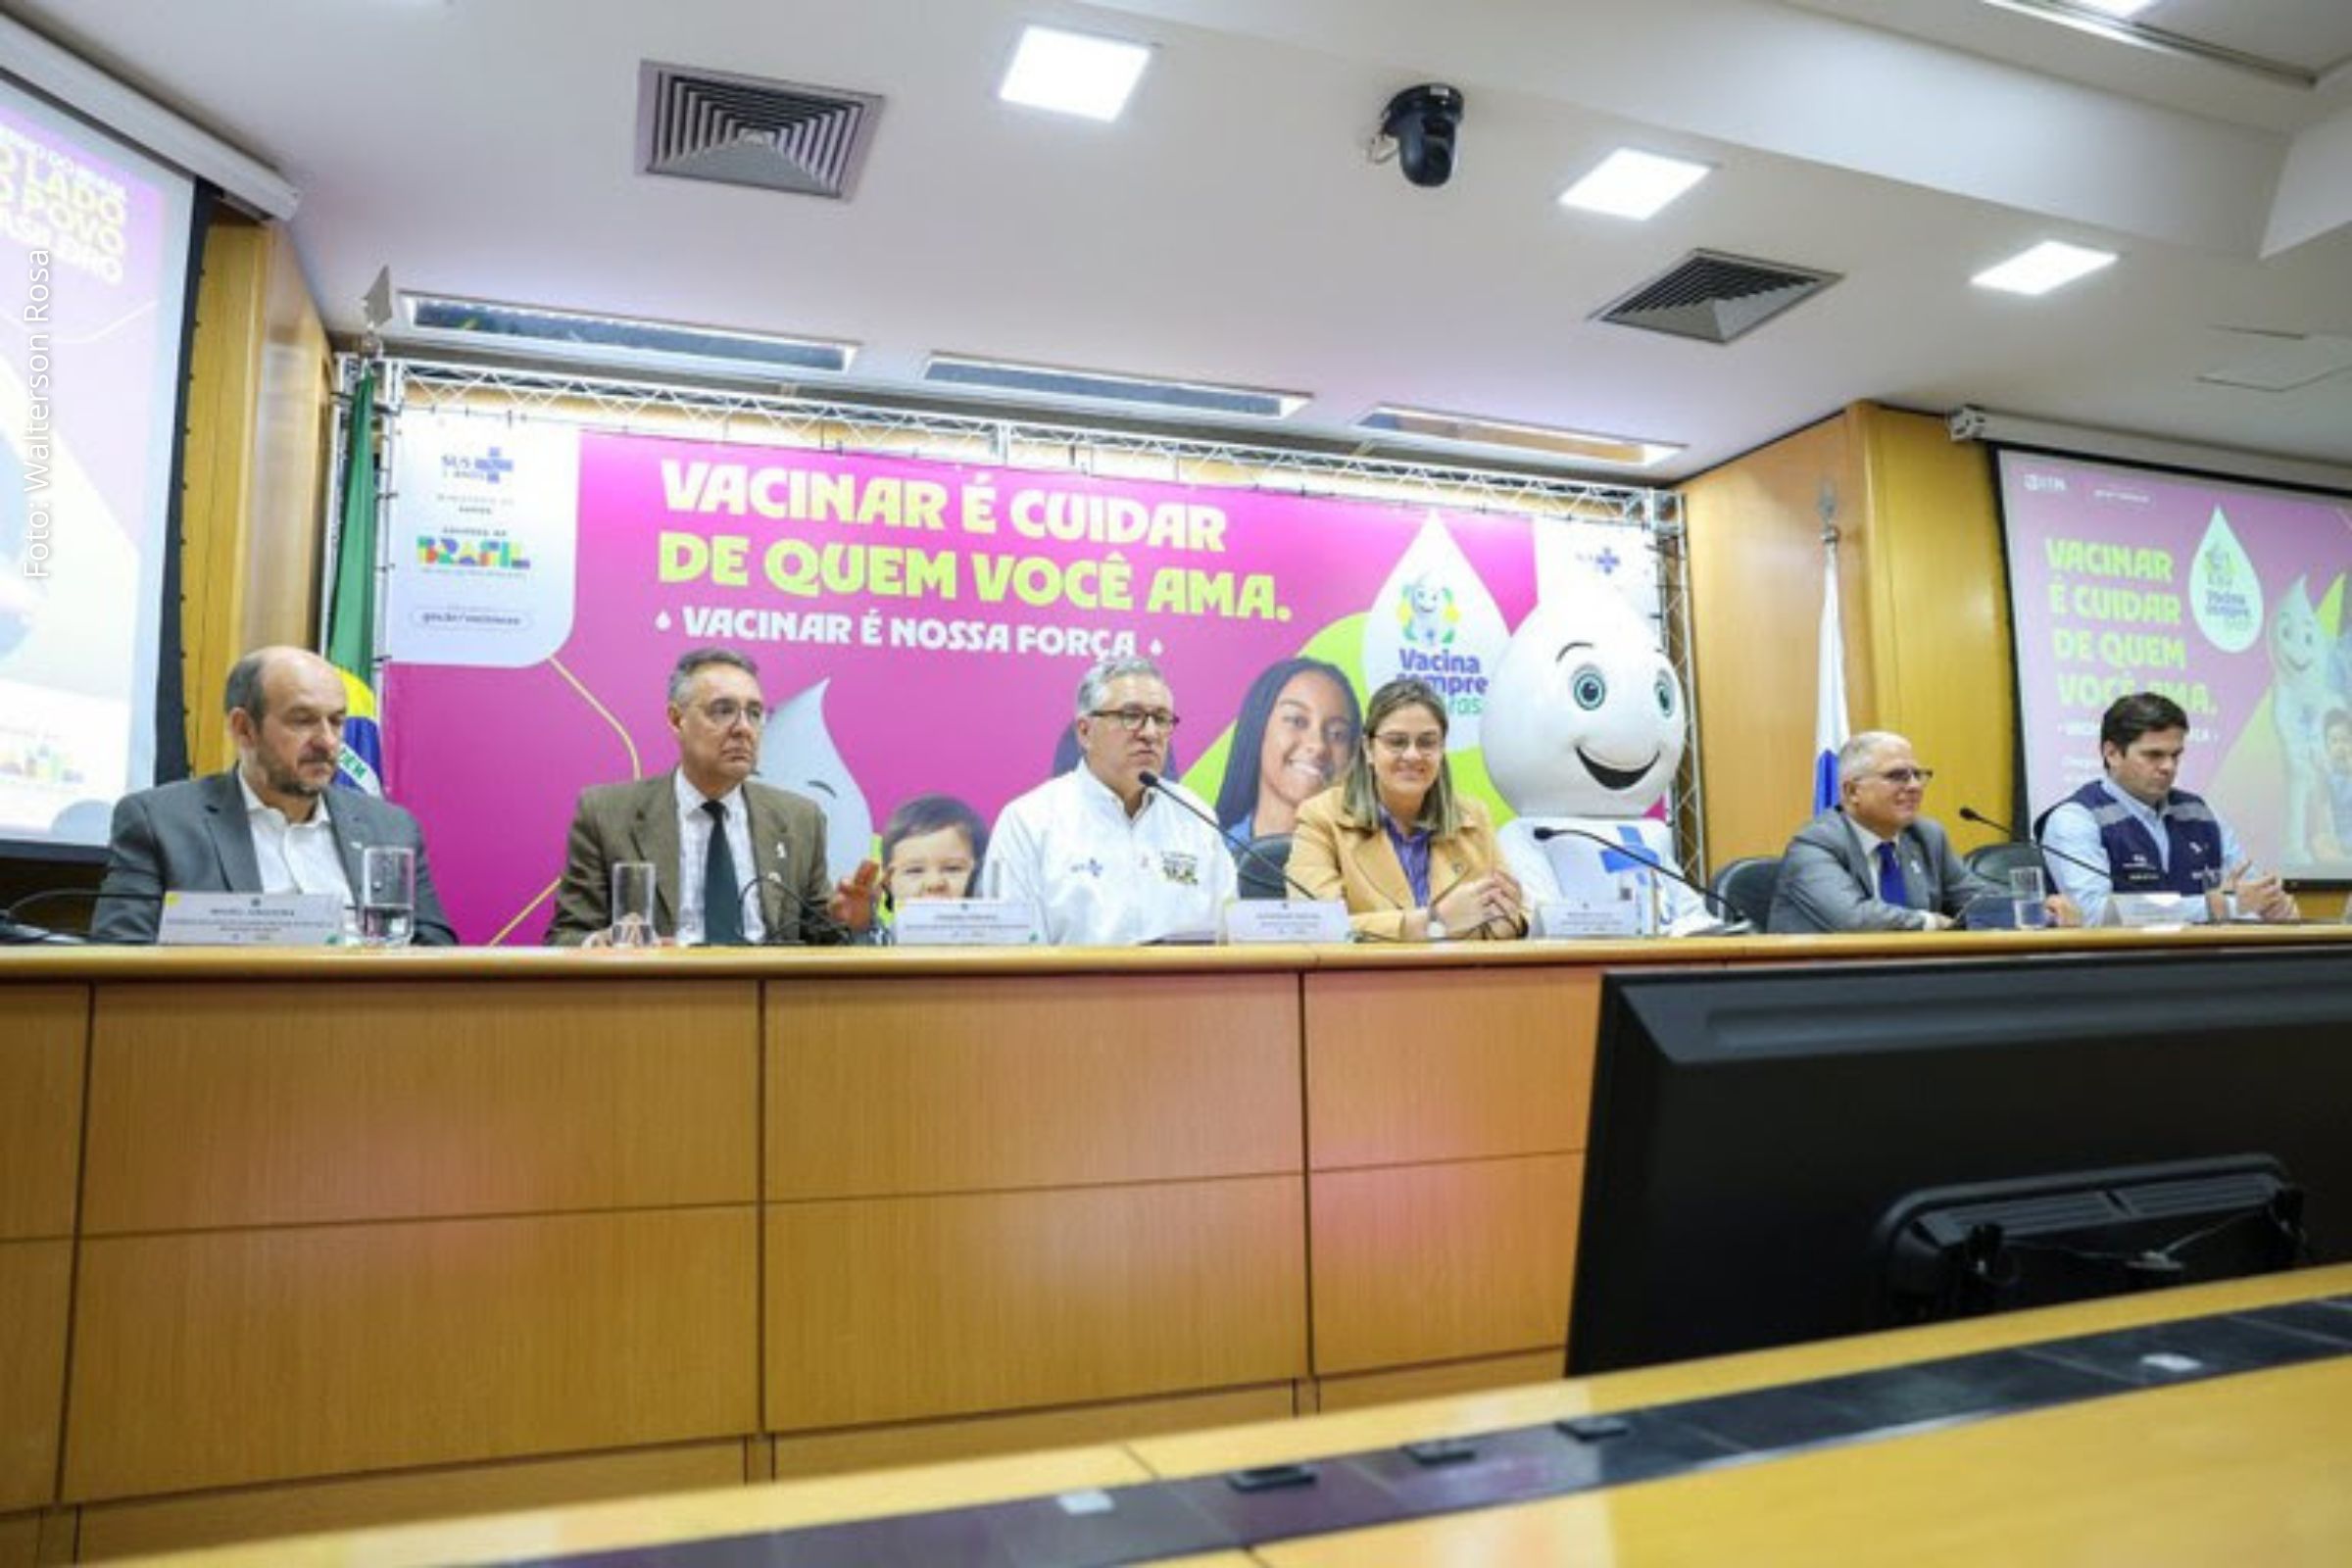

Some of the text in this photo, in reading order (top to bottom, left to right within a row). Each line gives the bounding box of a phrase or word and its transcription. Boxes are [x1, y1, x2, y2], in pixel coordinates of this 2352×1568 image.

[661, 459, 1227, 552] VACINAR É CUIDAR
[416, 535, 531, 570] BRASIL
[659, 530, 1293, 622] DE QUEM VOCÊ AMA.
[2045, 539, 2174, 584] VACINAR
[2049, 574, 2068, 615] É
[2074, 585, 2181, 625] CUIDAR
[682, 606, 1138, 662] VACINAR É NOSSA FORÇA
[2054, 627, 2186, 671] DE QUEM
[1398, 647, 1481, 675] Vacina
